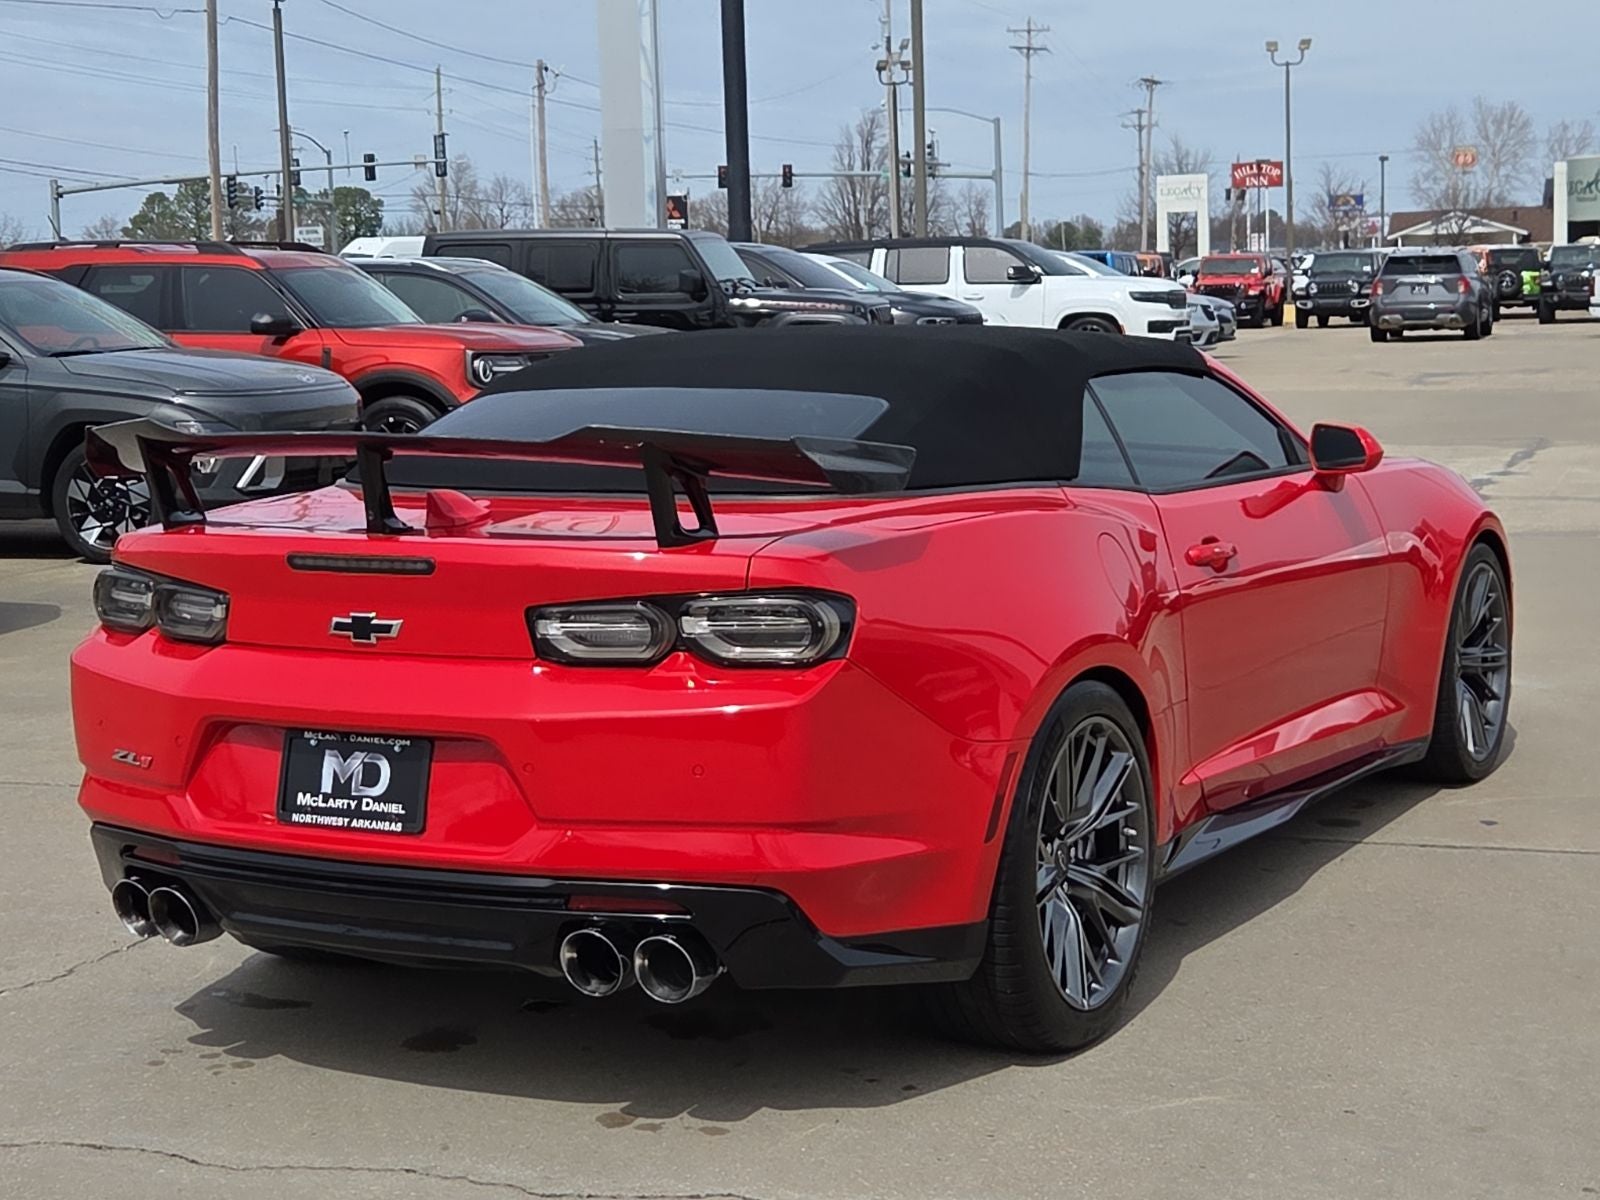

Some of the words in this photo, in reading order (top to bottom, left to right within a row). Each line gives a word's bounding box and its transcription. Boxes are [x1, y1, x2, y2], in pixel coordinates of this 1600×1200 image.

[1260, 163, 1281, 177] TOP
[1246, 176, 1268, 186] INN
[112, 748, 152, 769] ZL1
[320, 749, 391, 797] MD
[361, 797, 406, 815] DANIEL
[291, 812, 348, 828] NORTHWEST
[350, 817, 403, 832] ARKANSAS
